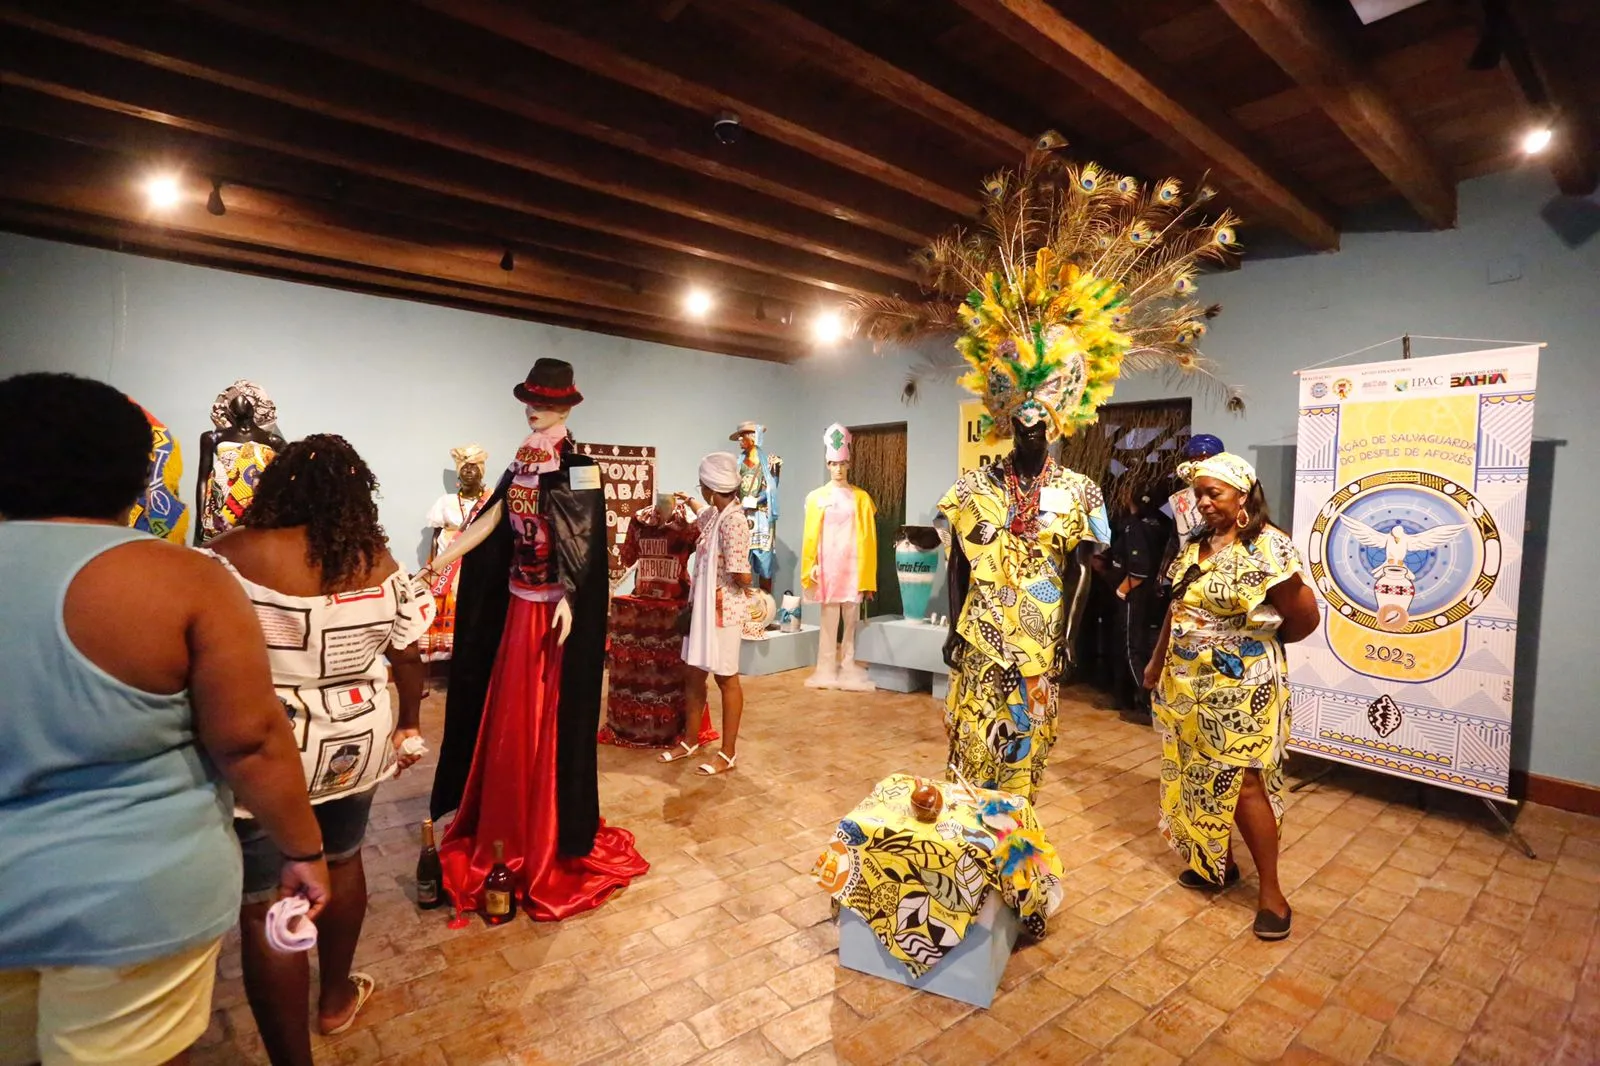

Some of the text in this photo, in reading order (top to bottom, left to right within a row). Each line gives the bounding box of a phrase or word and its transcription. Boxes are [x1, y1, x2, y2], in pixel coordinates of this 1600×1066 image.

[1411, 375, 1444, 388] IPAC
[1450, 373, 1507, 388] BAHIA
[1337, 433, 1477, 454] AÇÃO DE SALVAGUARDA
[1339, 447, 1474, 467] DO DESFILE DE AFOXÉS
[604, 480, 646, 500] ABÁ
[1364, 643, 1417, 669] 2023
